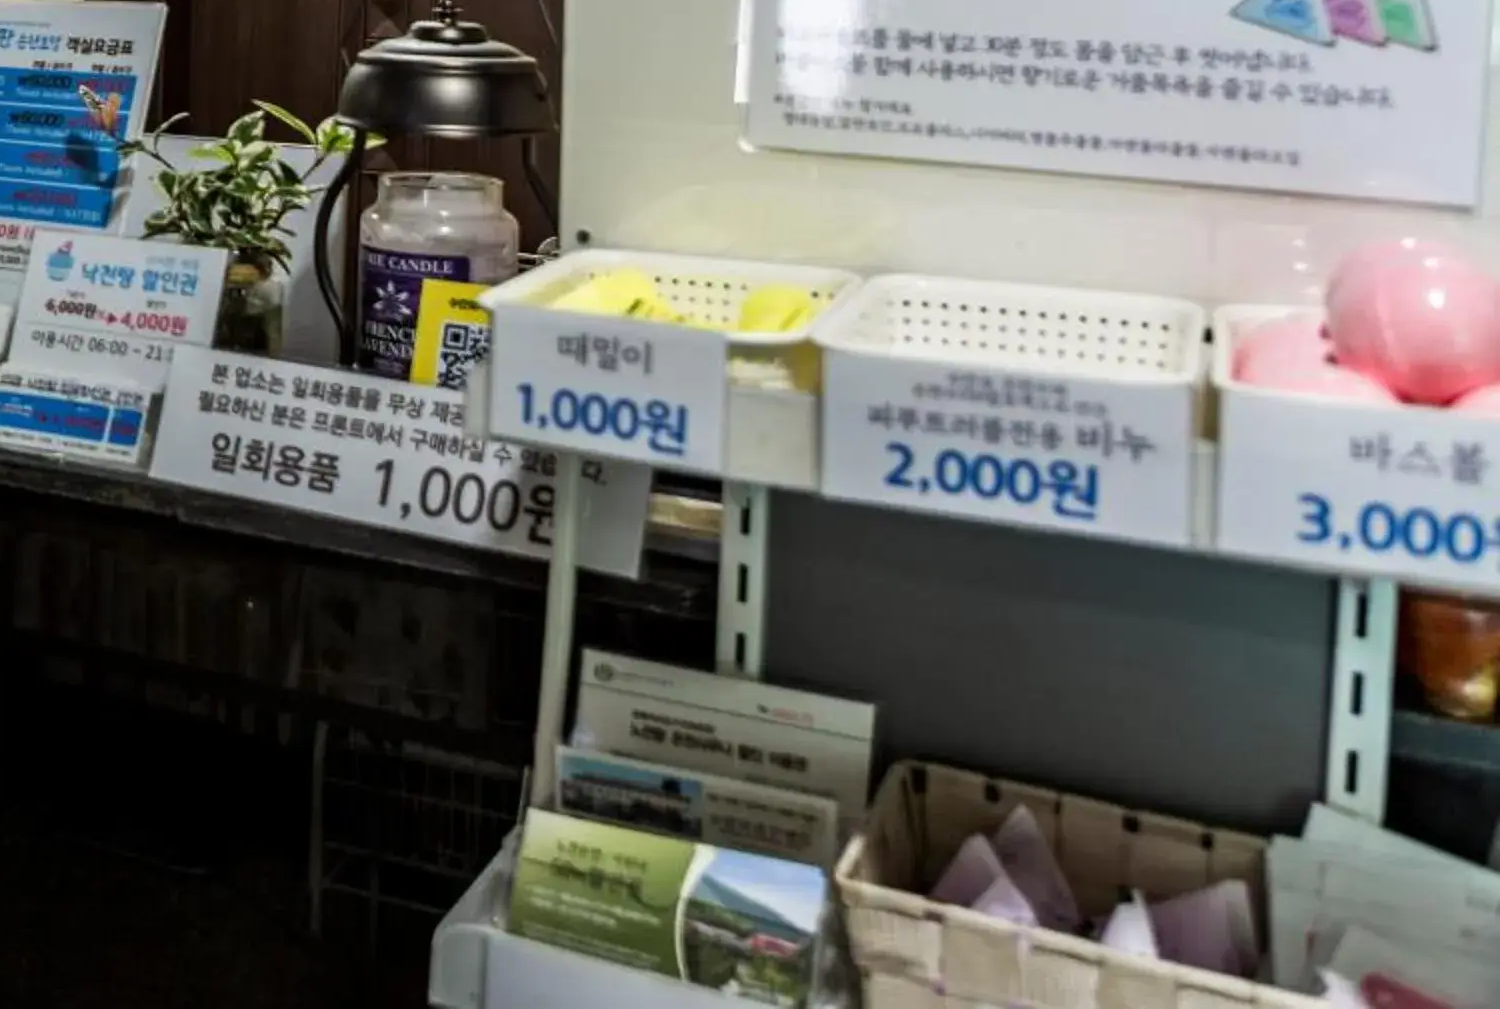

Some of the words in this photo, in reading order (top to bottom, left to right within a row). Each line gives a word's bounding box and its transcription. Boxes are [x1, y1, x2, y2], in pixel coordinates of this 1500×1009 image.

[388, 255, 453, 274] CANDLE
[31, 330, 86, 352] 이용시간
[120, 311, 189, 337] 4,000원
[556, 333, 654, 376] 때밀이
[211, 362, 230, 384] 본
[234, 366, 285, 396] 업소는
[386, 393, 426, 420] 무상
[515, 382, 690, 457] 1,000원
[198, 390, 266, 423] 필요하신
[270, 402, 306, 430] 분은
[310, 411, 404, 446] 프론트에서
[409, 428, 486, 464] 구매하실
[492, 445, 513, 467] 수
[1075, 419, 1156, 463] 비누
[210, 431, 342, 495] 일회용품
[884, 441, 1100, 521] 2,000원
[1296, 493, 1500, 567] 3,000
